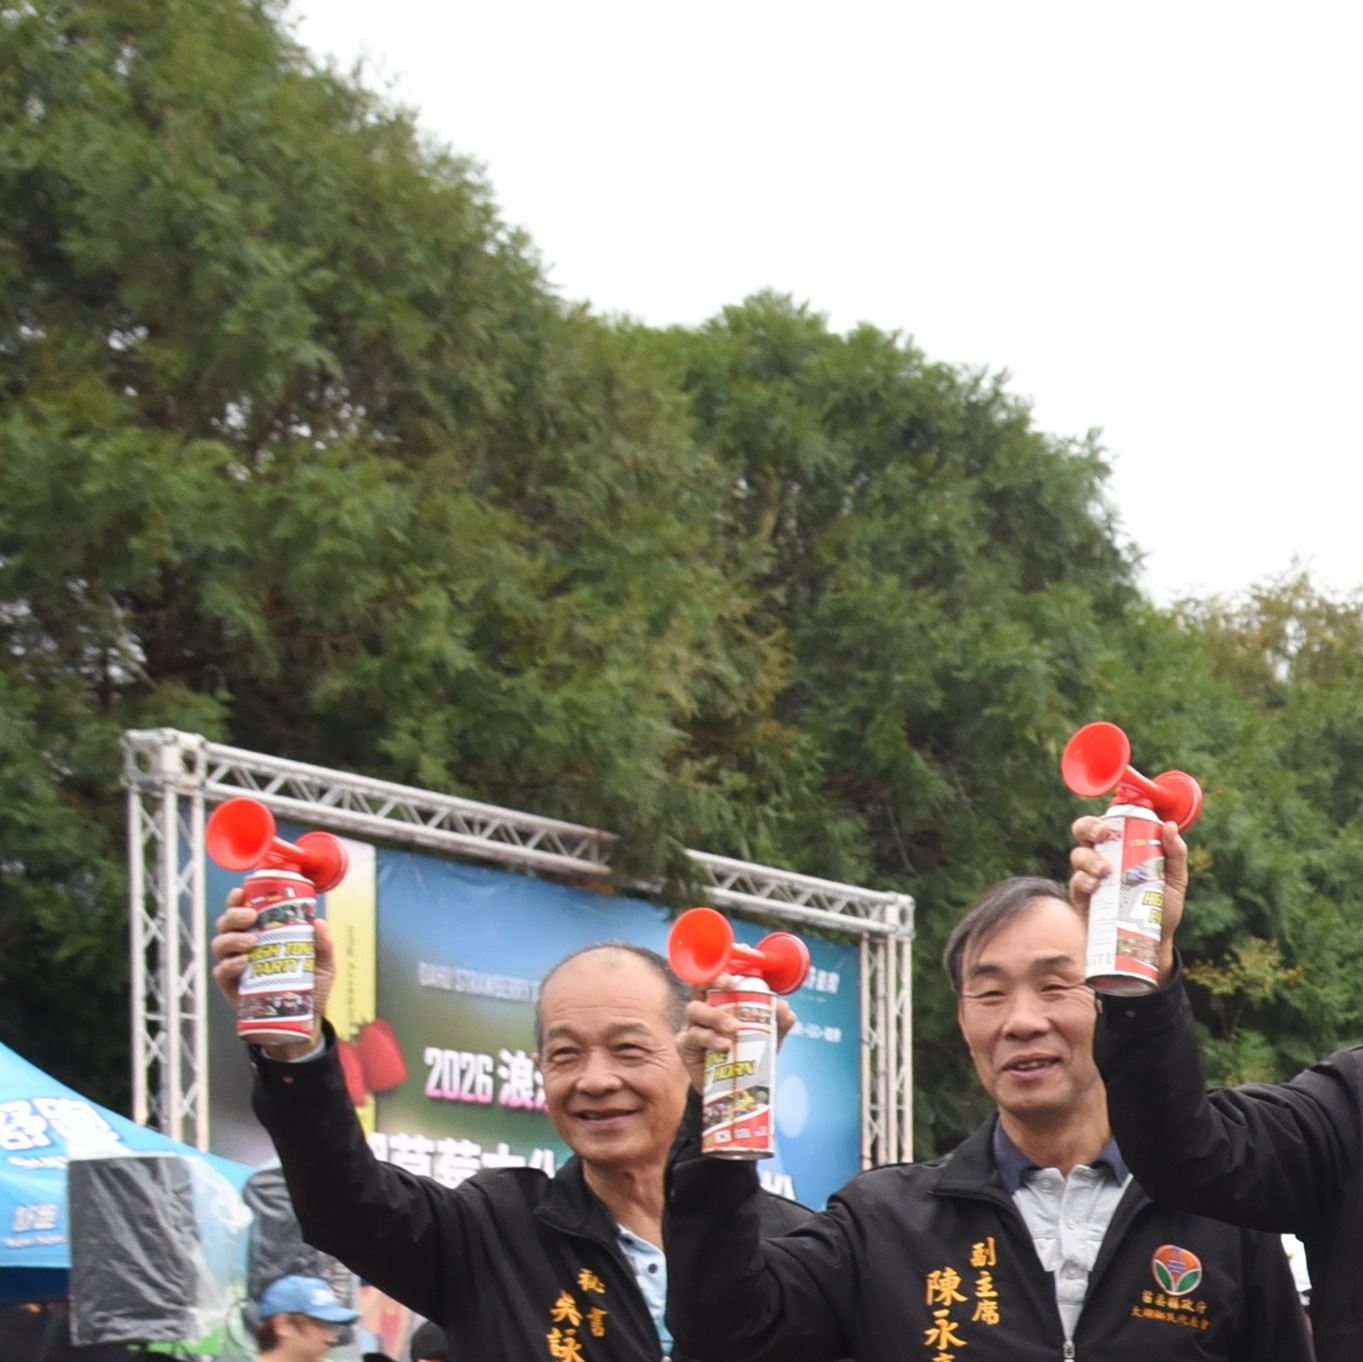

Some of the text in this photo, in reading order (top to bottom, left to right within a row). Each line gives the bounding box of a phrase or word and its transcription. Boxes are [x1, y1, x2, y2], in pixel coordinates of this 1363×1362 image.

[424, 1046, 494, 1104] 2026
[576, 1267, 608, 1337] 秘書
[969, 1236, 1001, 1326] 副主席
